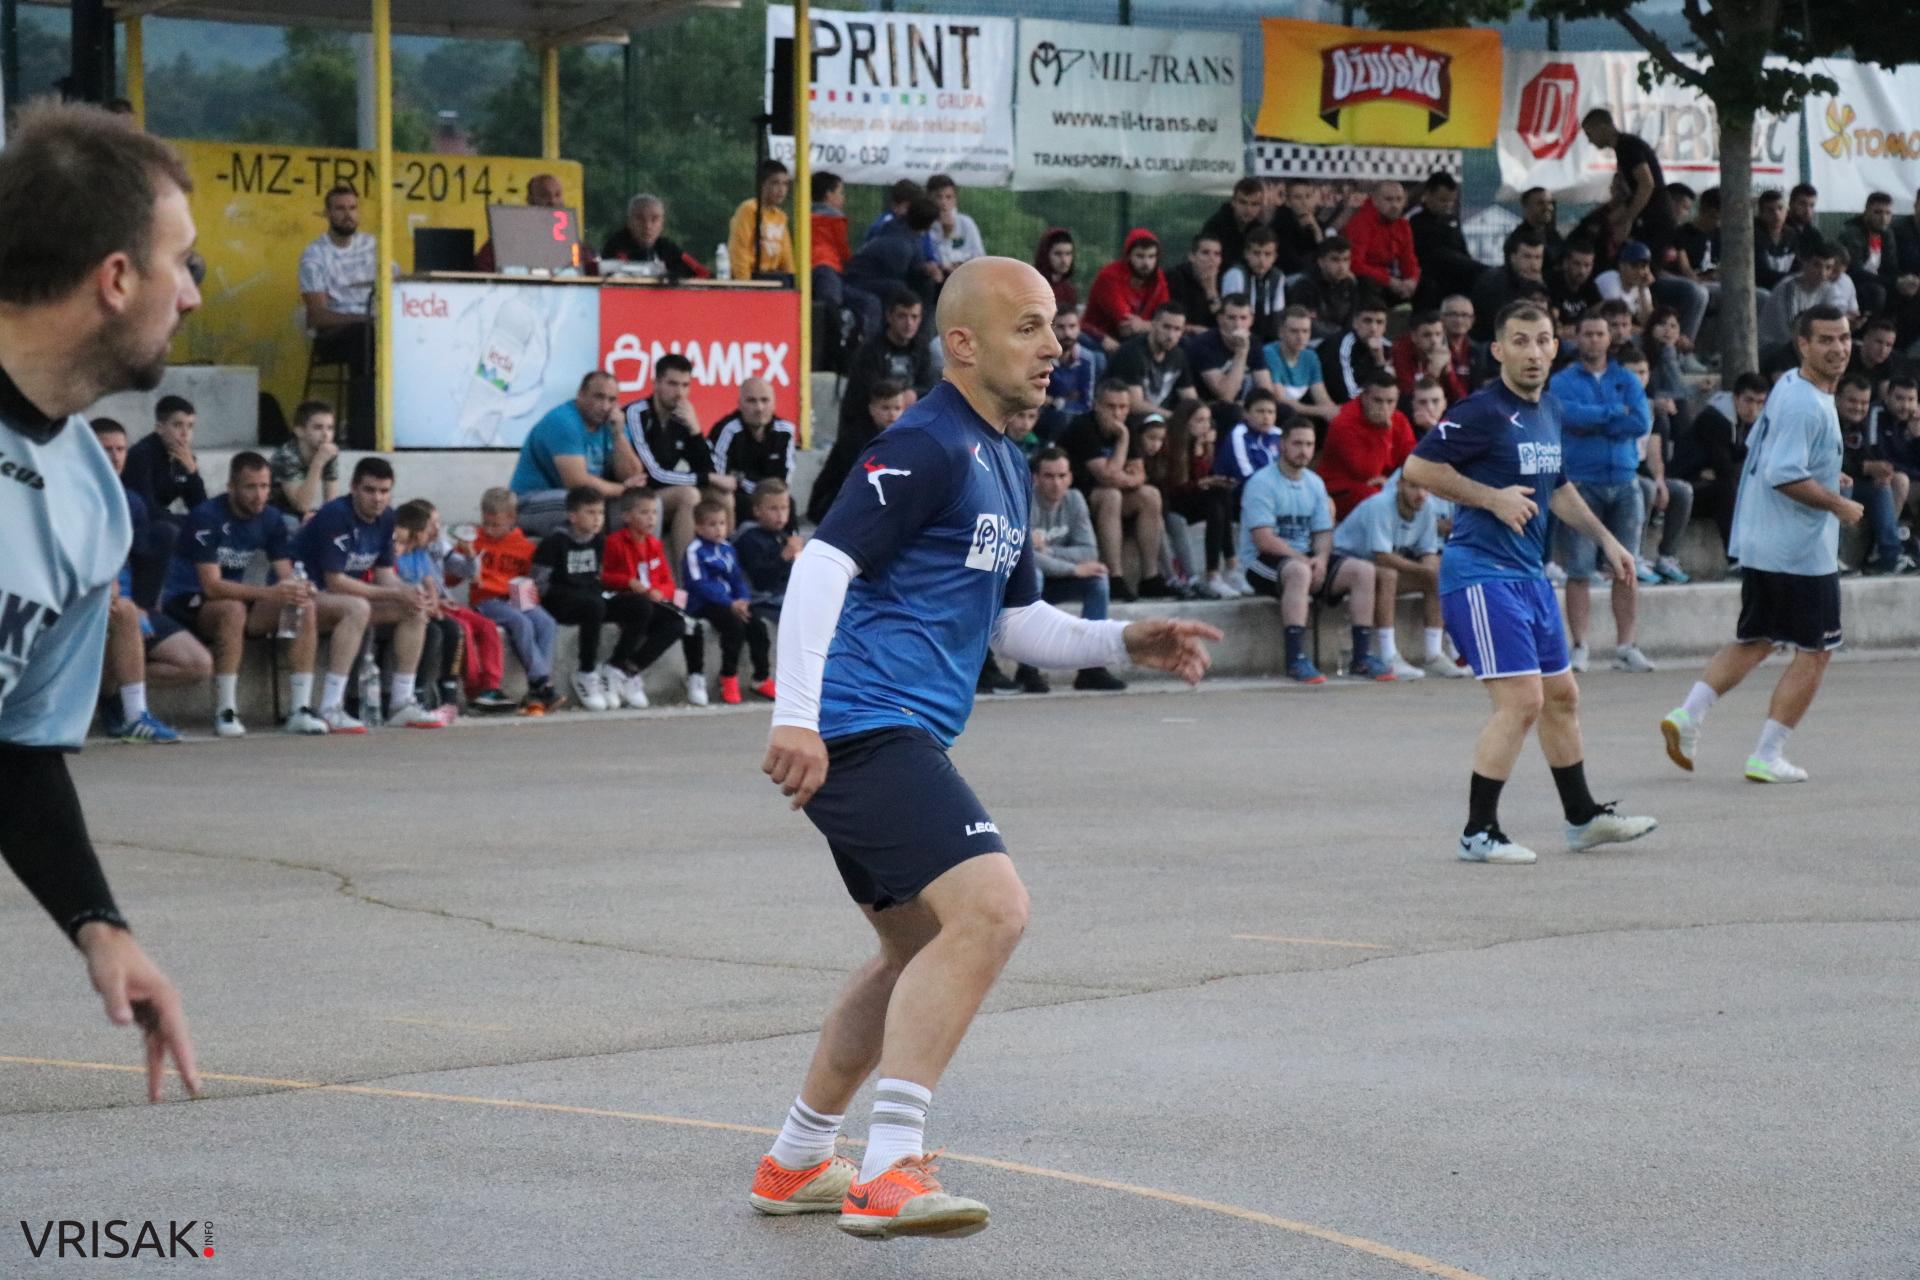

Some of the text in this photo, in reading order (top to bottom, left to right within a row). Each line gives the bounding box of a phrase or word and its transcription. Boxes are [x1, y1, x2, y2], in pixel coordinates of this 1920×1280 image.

[809, 17, 980, 89] PRINT
[1089, 50, 1236, 86] MIL-TRANS
[552, 210, 568, 241] 2
[402, 291, 449, 317] leda
